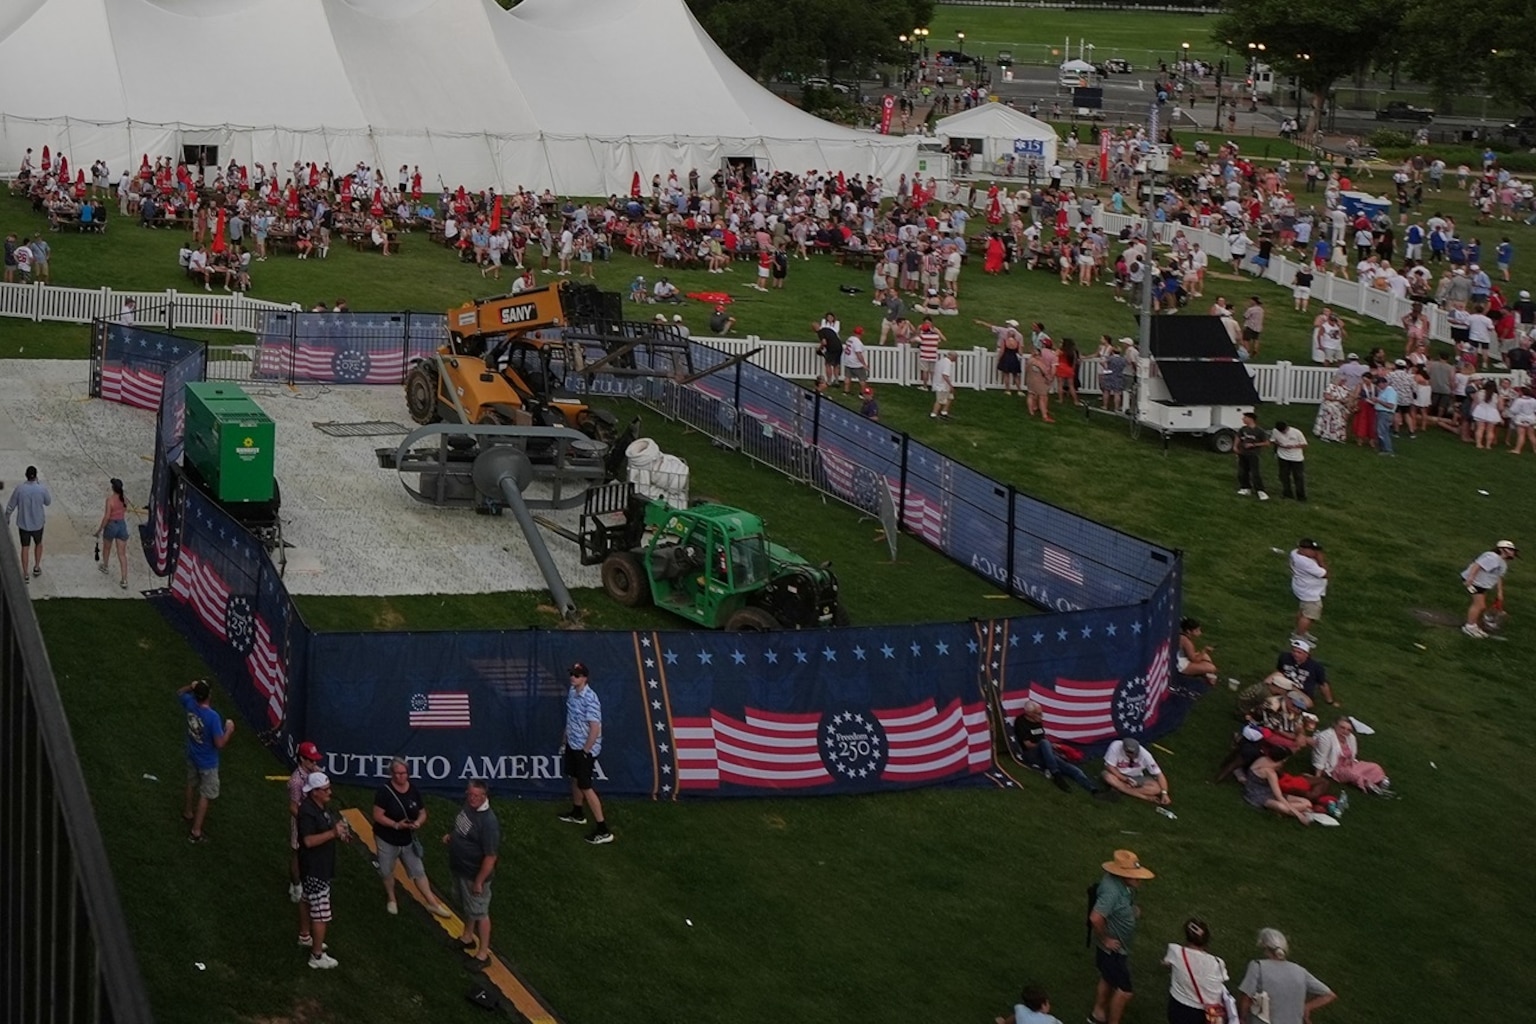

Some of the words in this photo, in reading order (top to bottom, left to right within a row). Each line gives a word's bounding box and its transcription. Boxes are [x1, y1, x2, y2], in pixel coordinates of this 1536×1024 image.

[1027, 141, 1041, 151] 15
[501, 304, 532, 324] SANY
[838, 740, 870, 762] 250
[405, 755, 452, 780] TO
[458, 755, 609, 781] AMERIA
